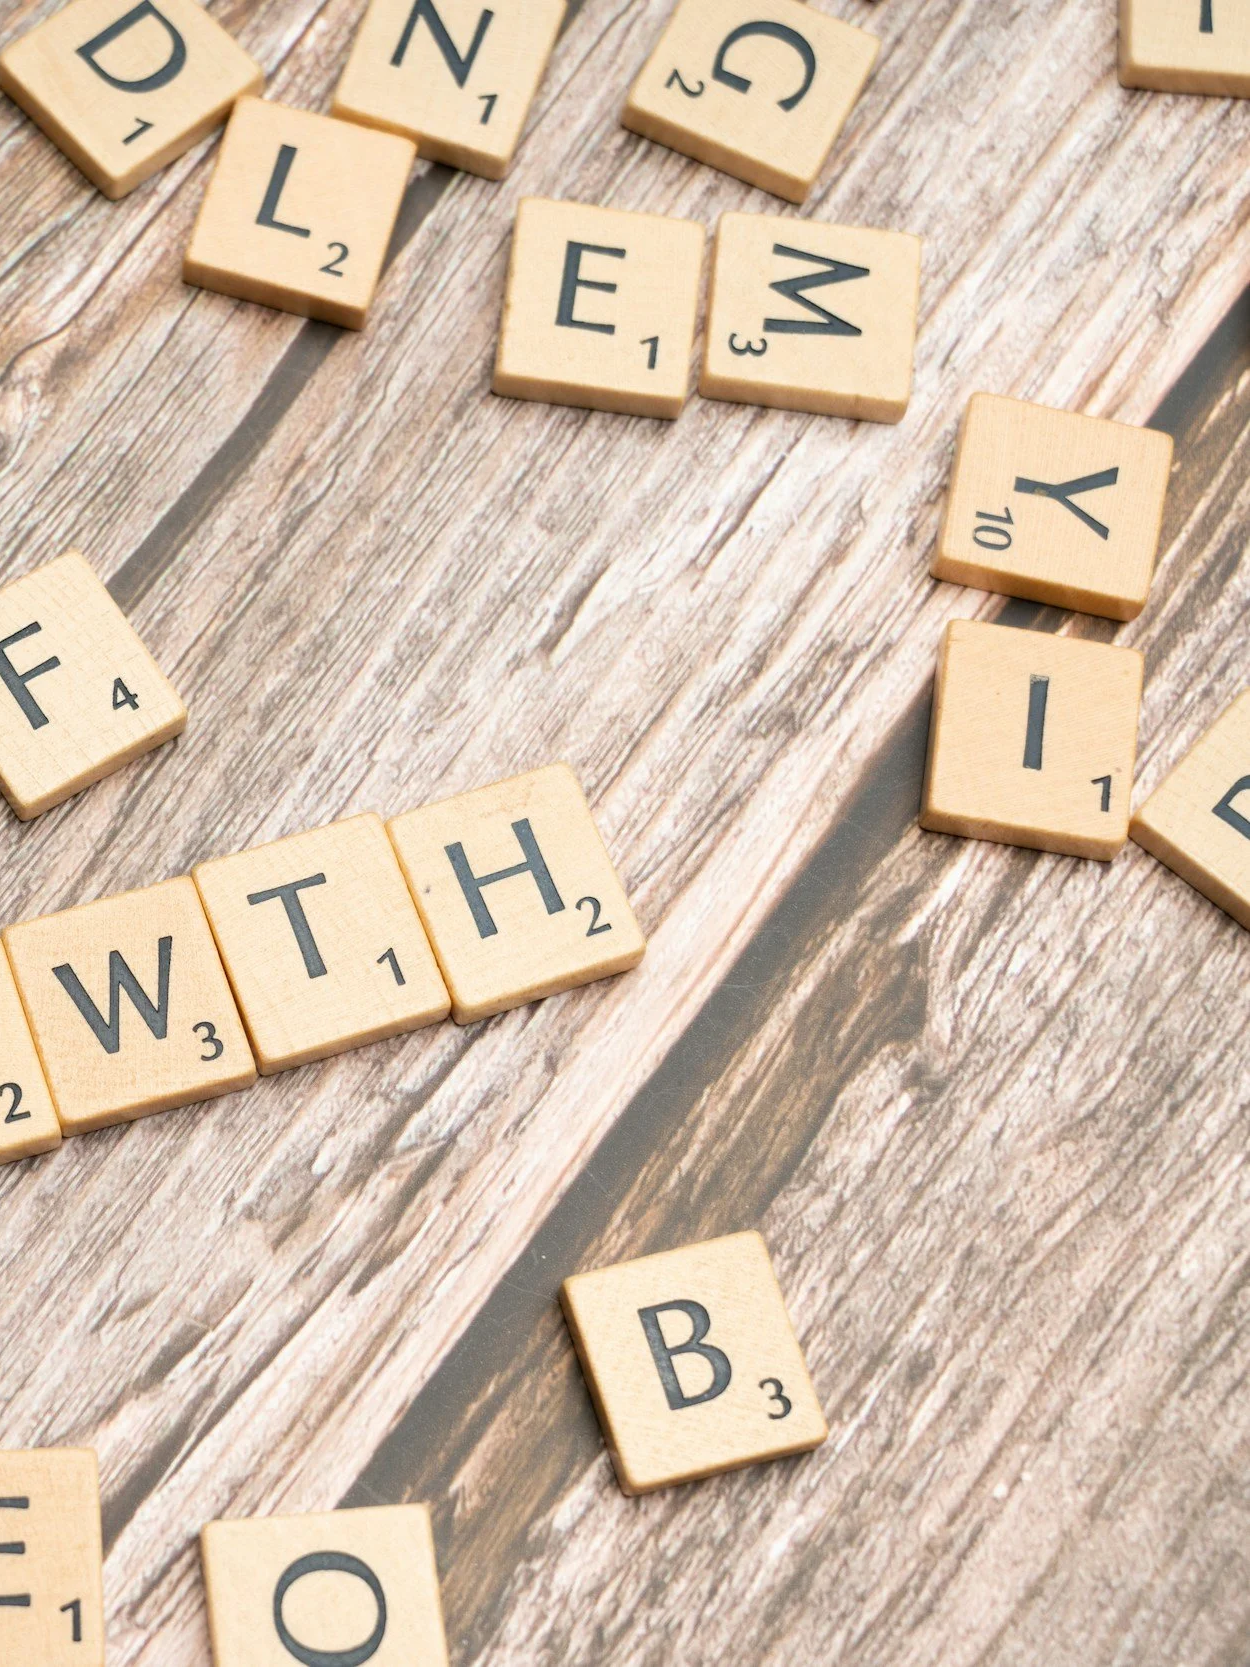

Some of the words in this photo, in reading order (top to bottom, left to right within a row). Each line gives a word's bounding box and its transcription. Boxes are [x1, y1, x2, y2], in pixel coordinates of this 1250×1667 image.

[75, 0, 187, 94] D
[390, 0, 495, 89] N
[711, 20, 817, 112] G
[255, 143, 311, 239] L
[554, 240, 627, 336] E
[762, 243, 871, 337] M
[1013, 466, 1120, 541] Y
[1022, 676, 1050, 771] I
[636, 1298, 733, 1411] B
